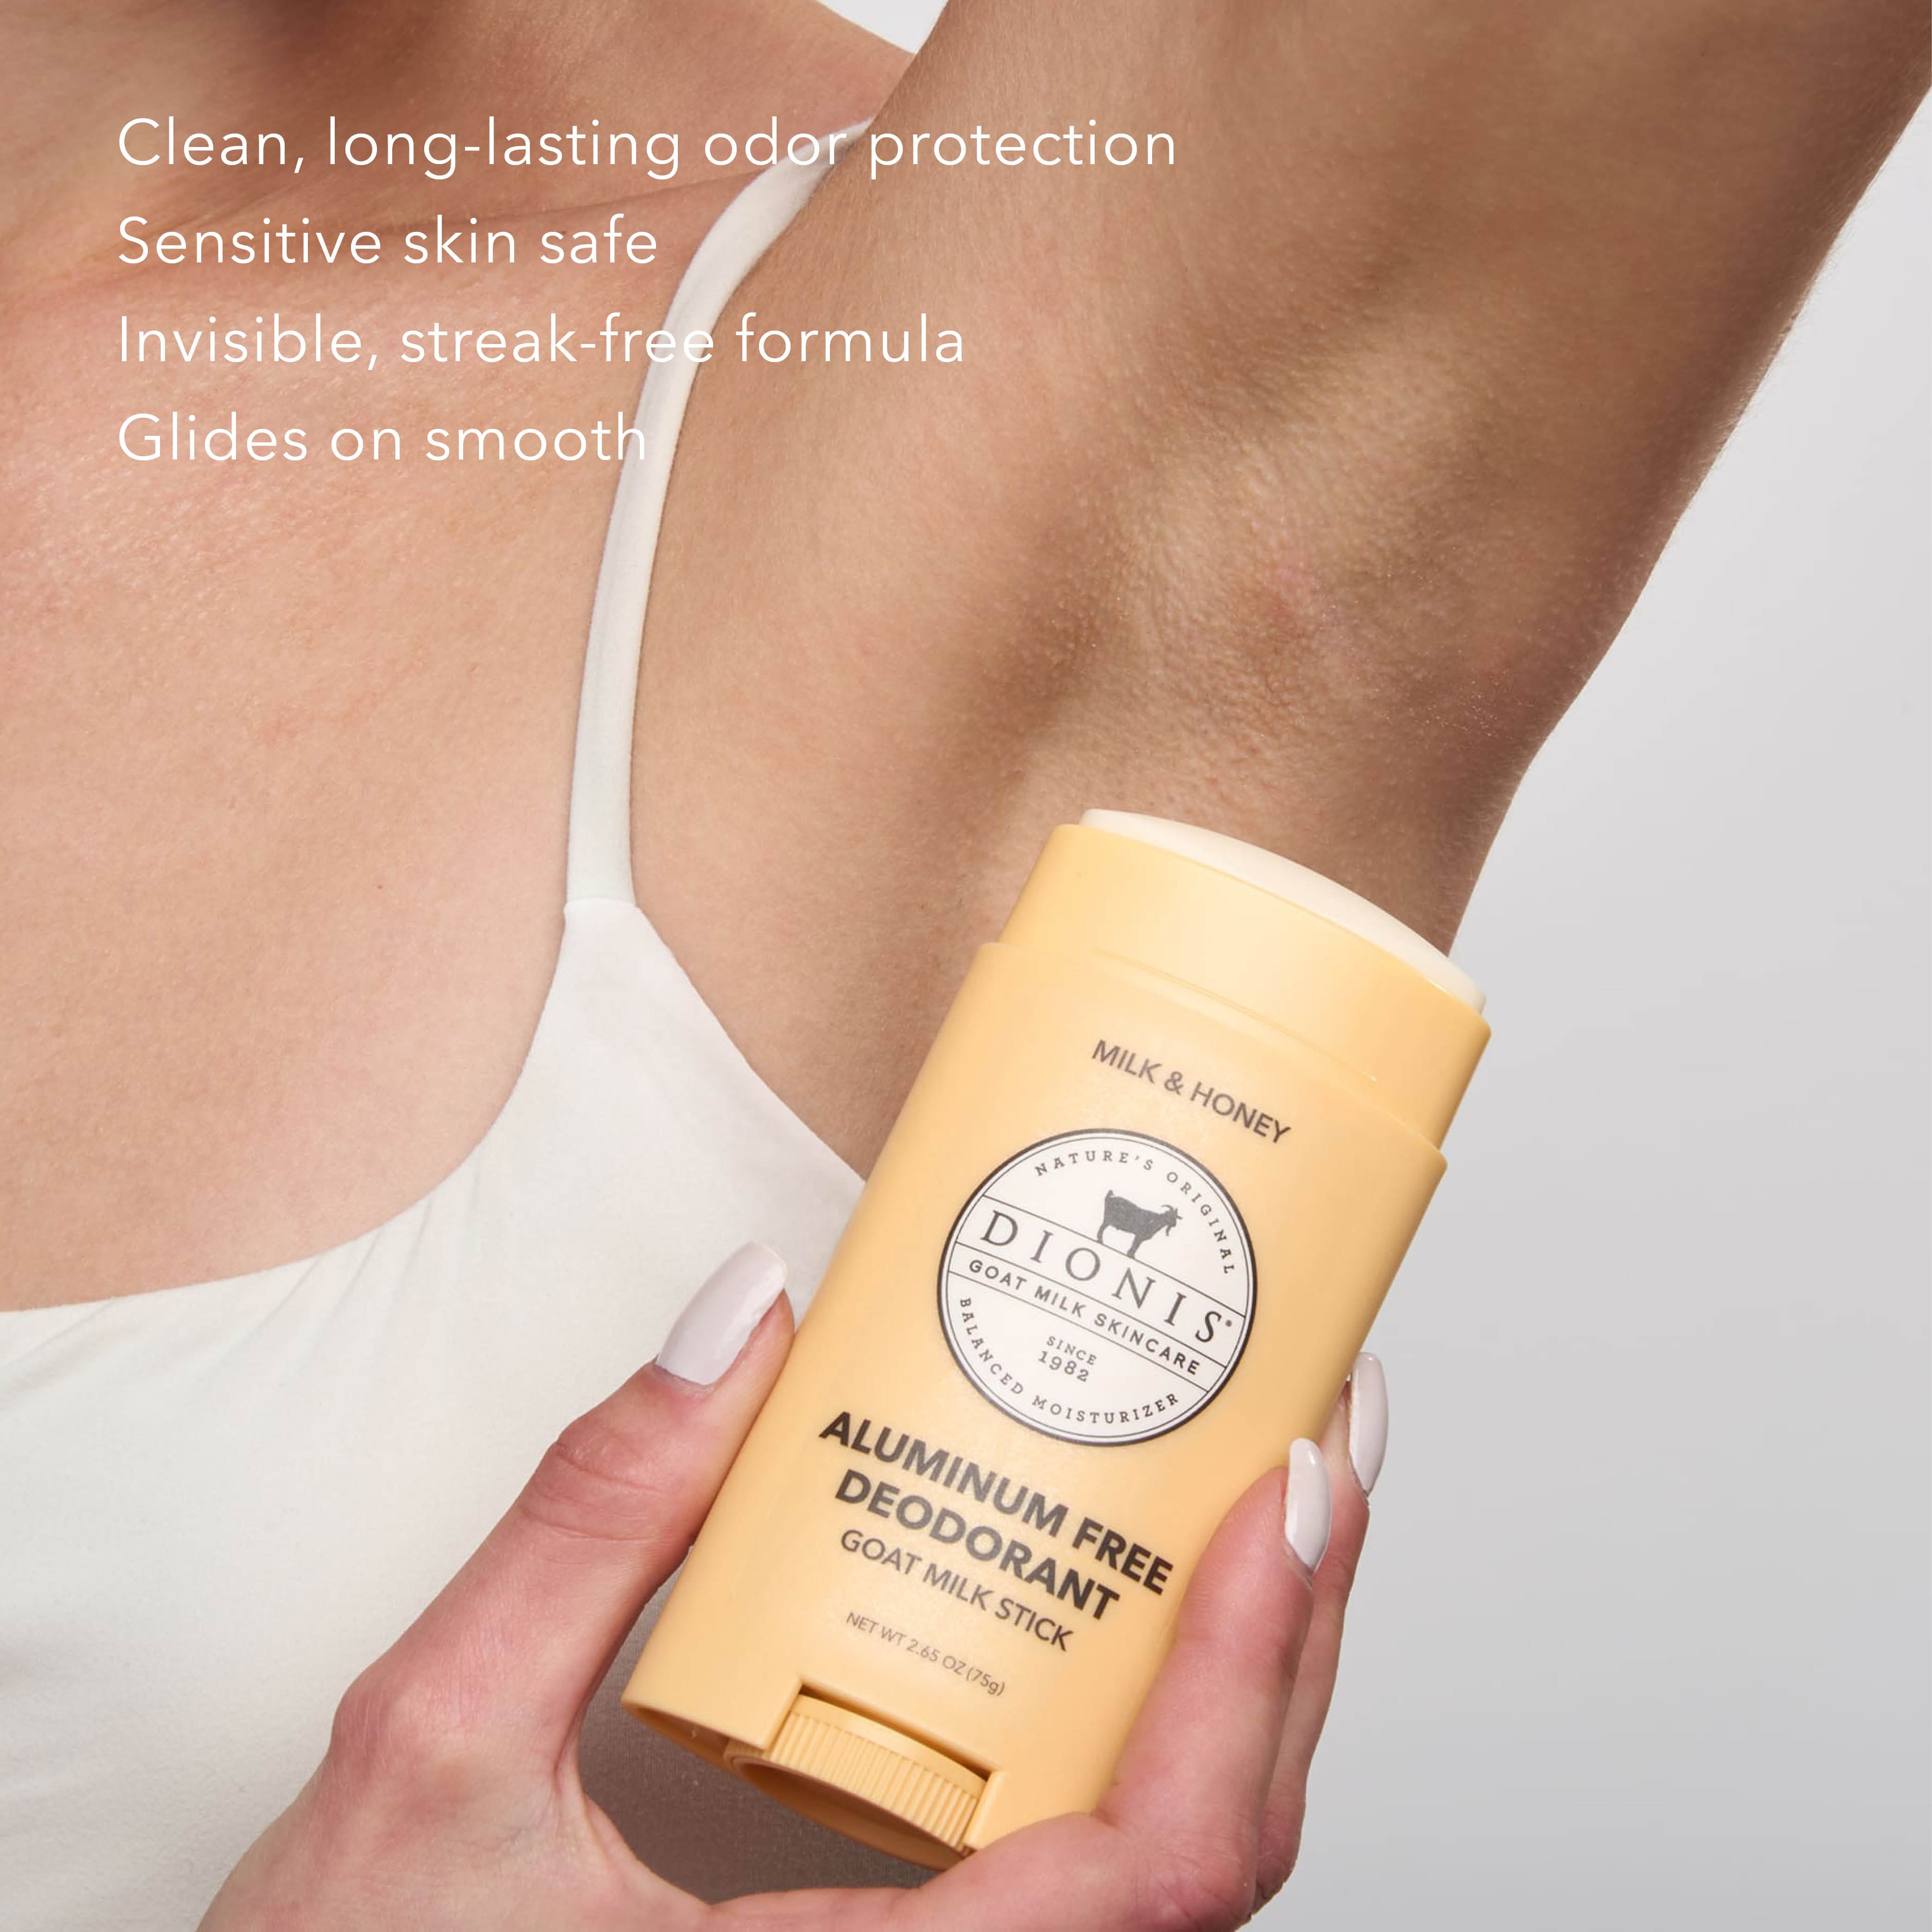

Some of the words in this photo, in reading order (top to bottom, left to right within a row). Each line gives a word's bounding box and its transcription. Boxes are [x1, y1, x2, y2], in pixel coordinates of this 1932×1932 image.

[1092, 1040, 1162, 1084] MILK
[1164, 1071, 1185, 1095] &
[1189, 1082, 1291, 1144] HONEY
[1034, 1150, 1154, 1176] NATURE'S
[1167, 1171, 1234, 1274] ORIGINAL
[960, 1298, 1024, 1395] BALANCED
[1032, 1393, 1179, 1423] MOISTURIZER
[969, 1259, 1027, 1290] GOAT
[1034, 1285, 1086, 1317] MILK
[1094, 1313, 1200, 1375] SKINCARE
[1038, 1351, 1090, 1383] 1982
[1046, 1335, 1097, 1365] SINCE
[819, 1411, 1069, 1537] ALUMINUM
[1072, 1517, 1173, 1595] FREE
[835, 1469, 1120, 1620] DEODORANT
[841, 1529, 923, 1575] GOAT
[923, 1562, 994, 1611] MILK
[995, 1598, 1074, 1651] STICK
[846, 1612, 879, 1635] NET
[881, 1626, 907, 1645] WT
[906, 1638, 939, 1662] 2.65
[942, 1655, 968, 1675] OZ
[966, 1666, 1005, 1696] (75g)
